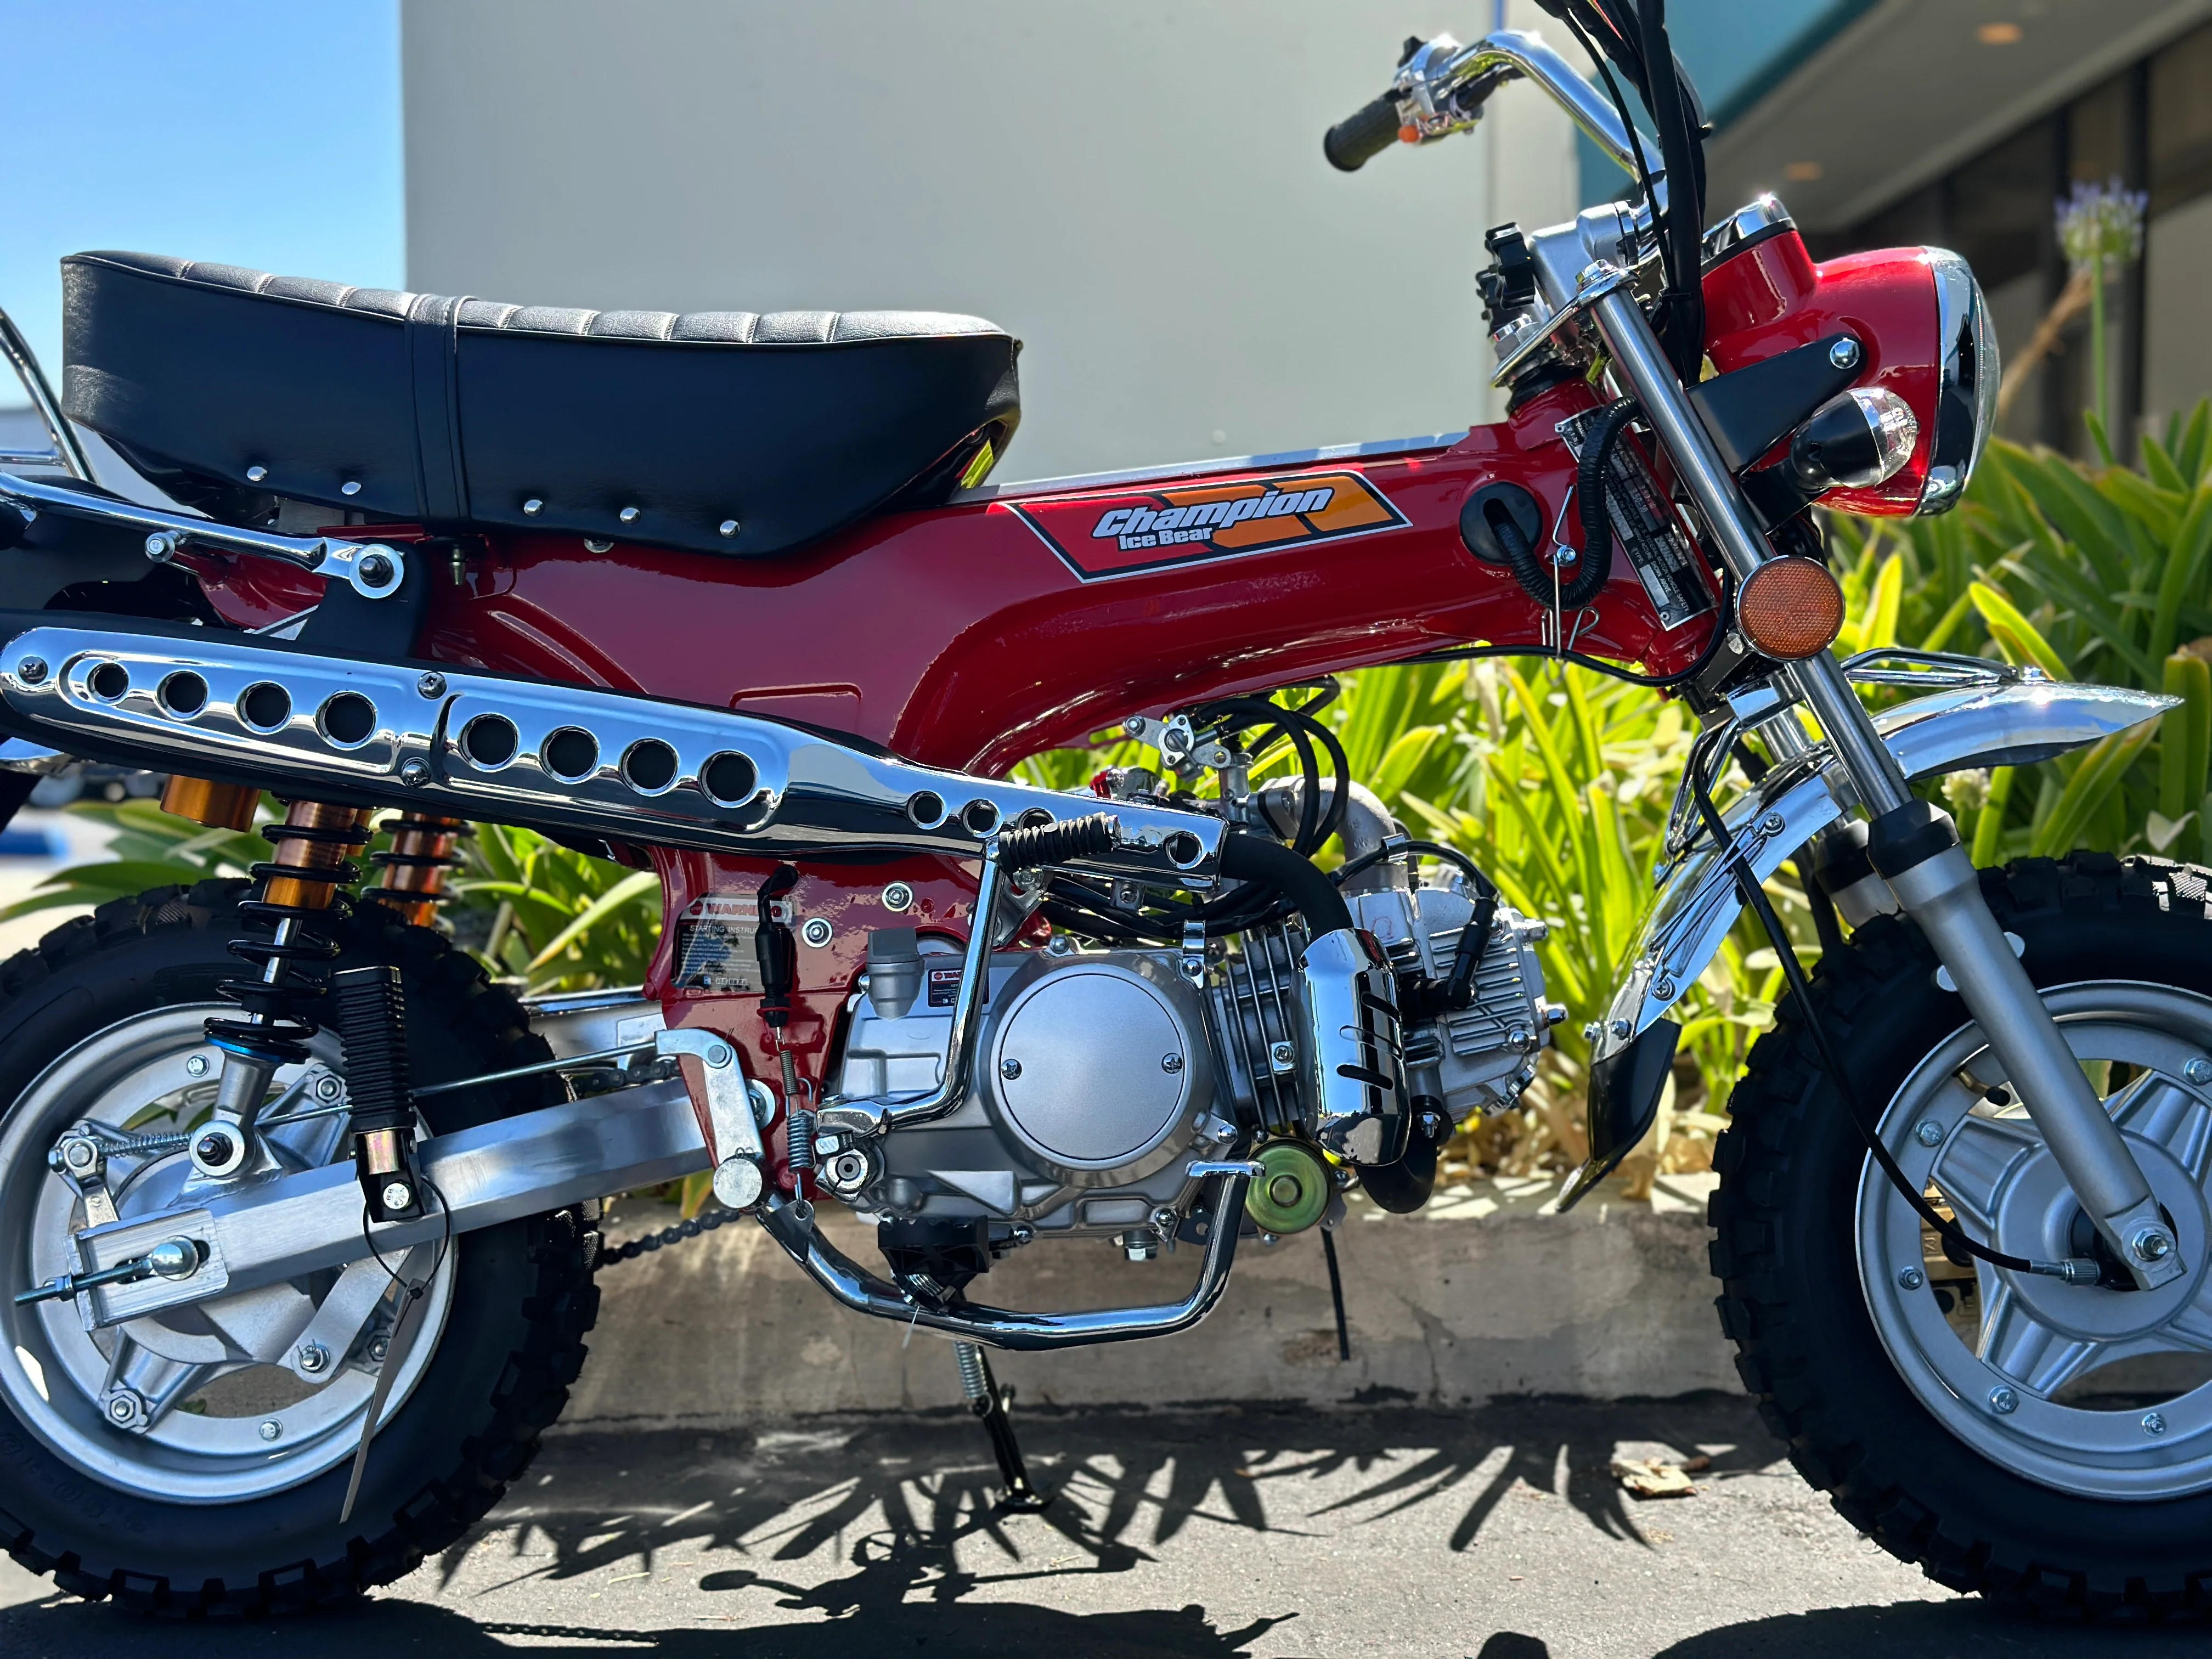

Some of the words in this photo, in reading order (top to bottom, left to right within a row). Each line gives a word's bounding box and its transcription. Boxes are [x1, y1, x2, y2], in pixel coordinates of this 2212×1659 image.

[1092, 488, 1334, 538] Champion
[1119, 534, 1156, 550] Ice
[1158, 527, 1213, 545] Bear
[1632, 527, 1654, 560] MANUFACTURE
[1650, 560, 1662, 577] SHOWN
[1644, 534, 1660, 557] FEDERAL
[1655, 555, 1669, 574] MOTOR
[1664, 572, 1680, 594] VEHICLE
[1675, 592, 1690, 612] SAFETY
[690, 924, 725, 933] STARTING
